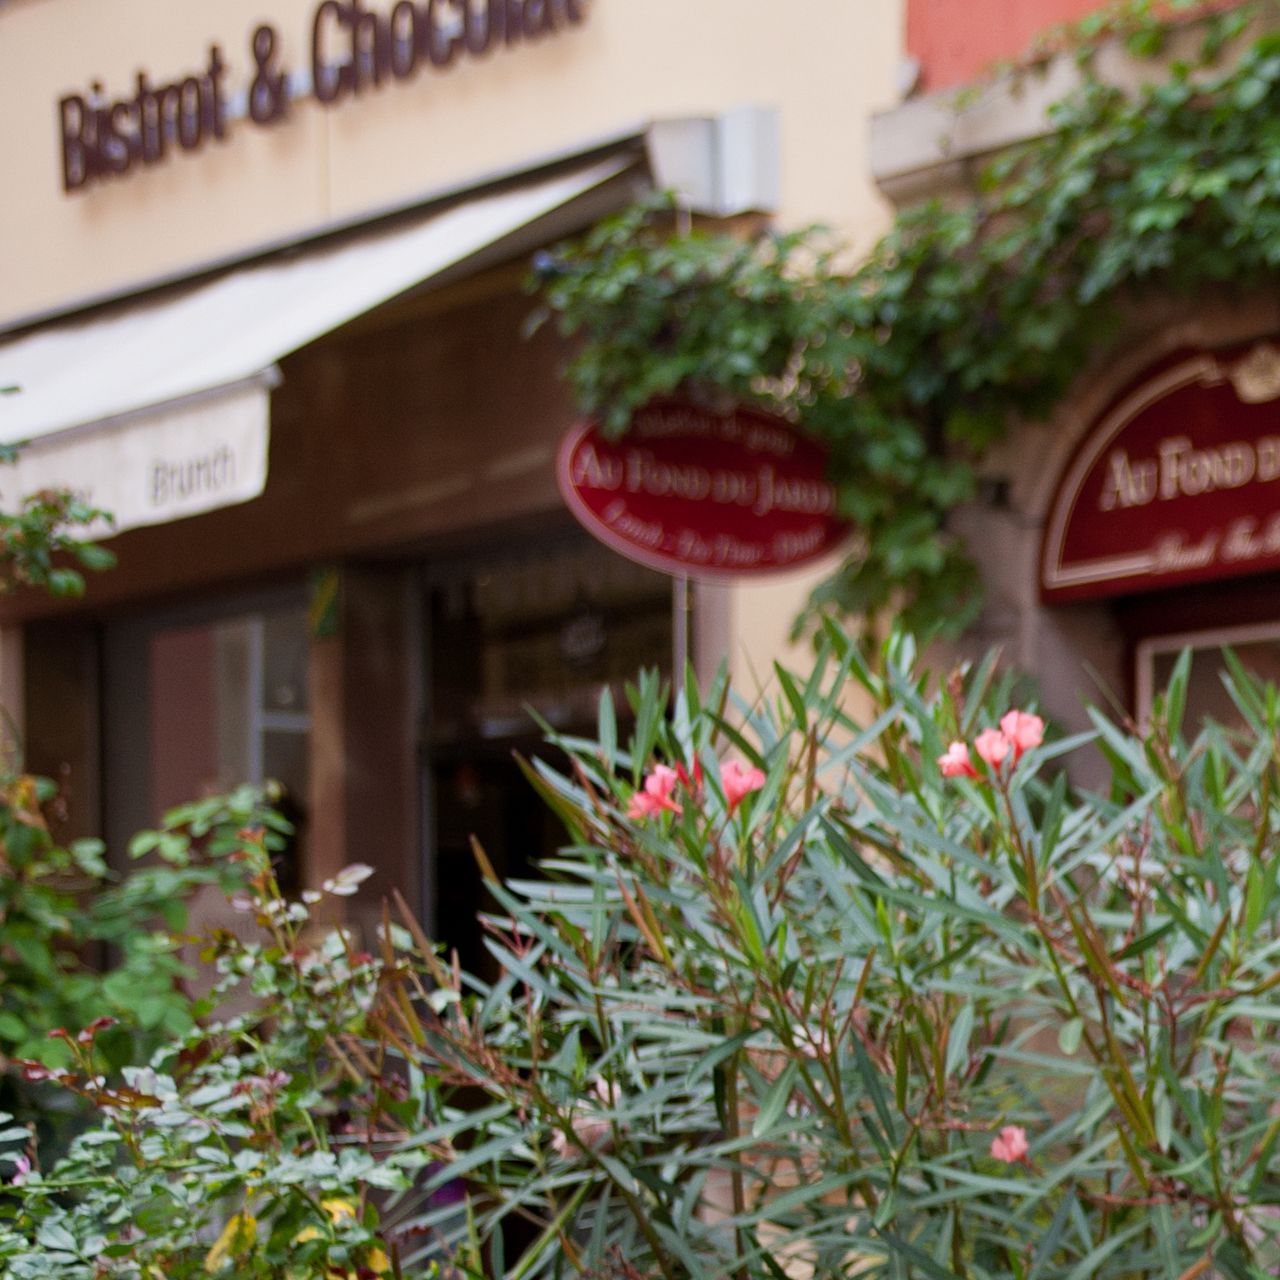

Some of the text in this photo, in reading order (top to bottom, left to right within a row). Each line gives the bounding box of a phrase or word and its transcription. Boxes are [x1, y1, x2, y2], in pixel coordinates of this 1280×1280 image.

[58, 0, 583, 193] Bistrot & Choco
[150, 443, 234, 504] Brunch
[752, 464, 836, 516] JARDI
